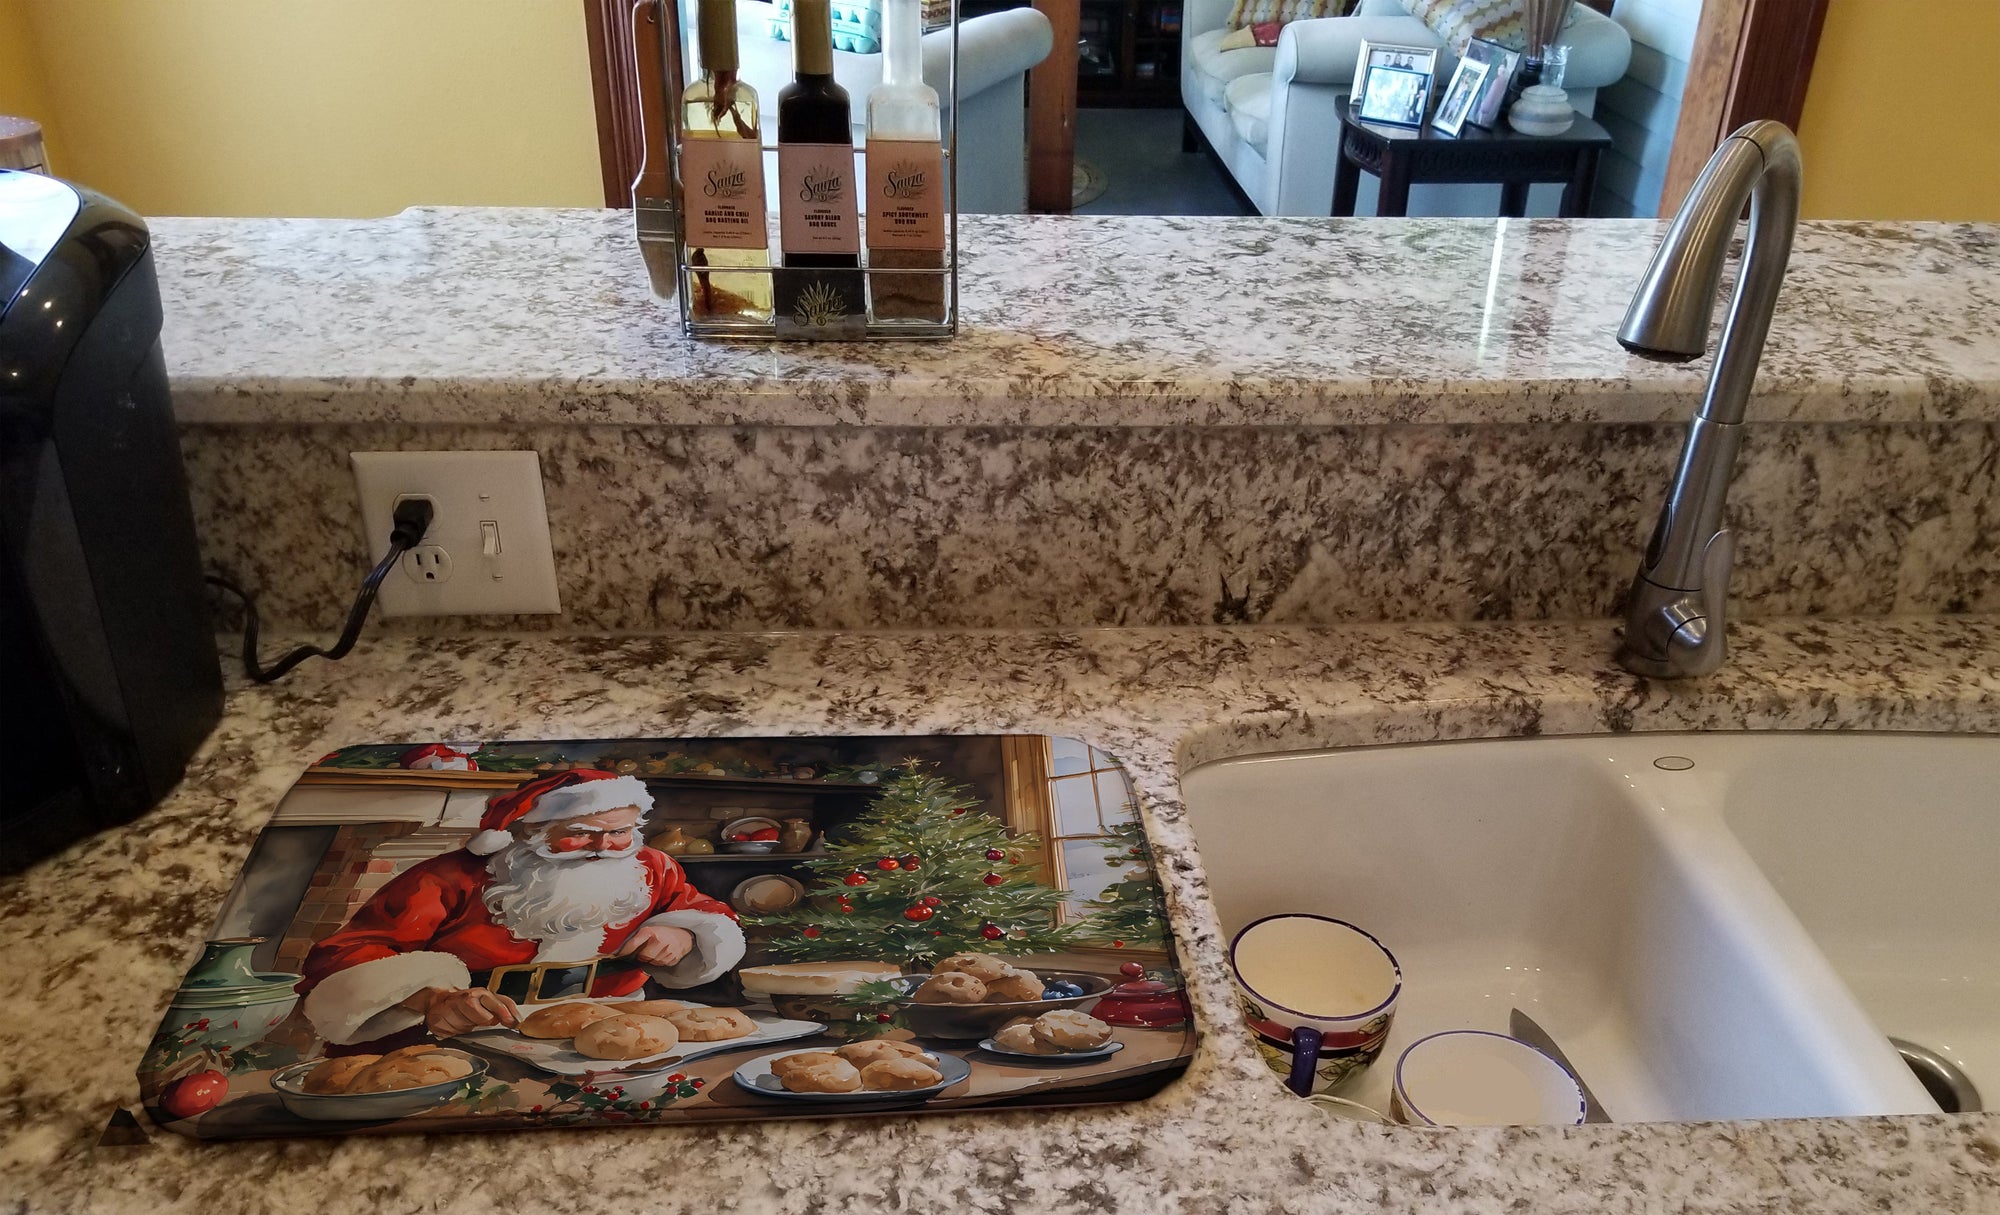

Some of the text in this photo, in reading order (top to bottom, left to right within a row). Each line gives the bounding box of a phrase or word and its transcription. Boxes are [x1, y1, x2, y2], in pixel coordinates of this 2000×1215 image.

[703, 169, 745, 197] Sauza
[800, 175, 841, 202] Sauza
[884, 171, 925, 198] Sauza
